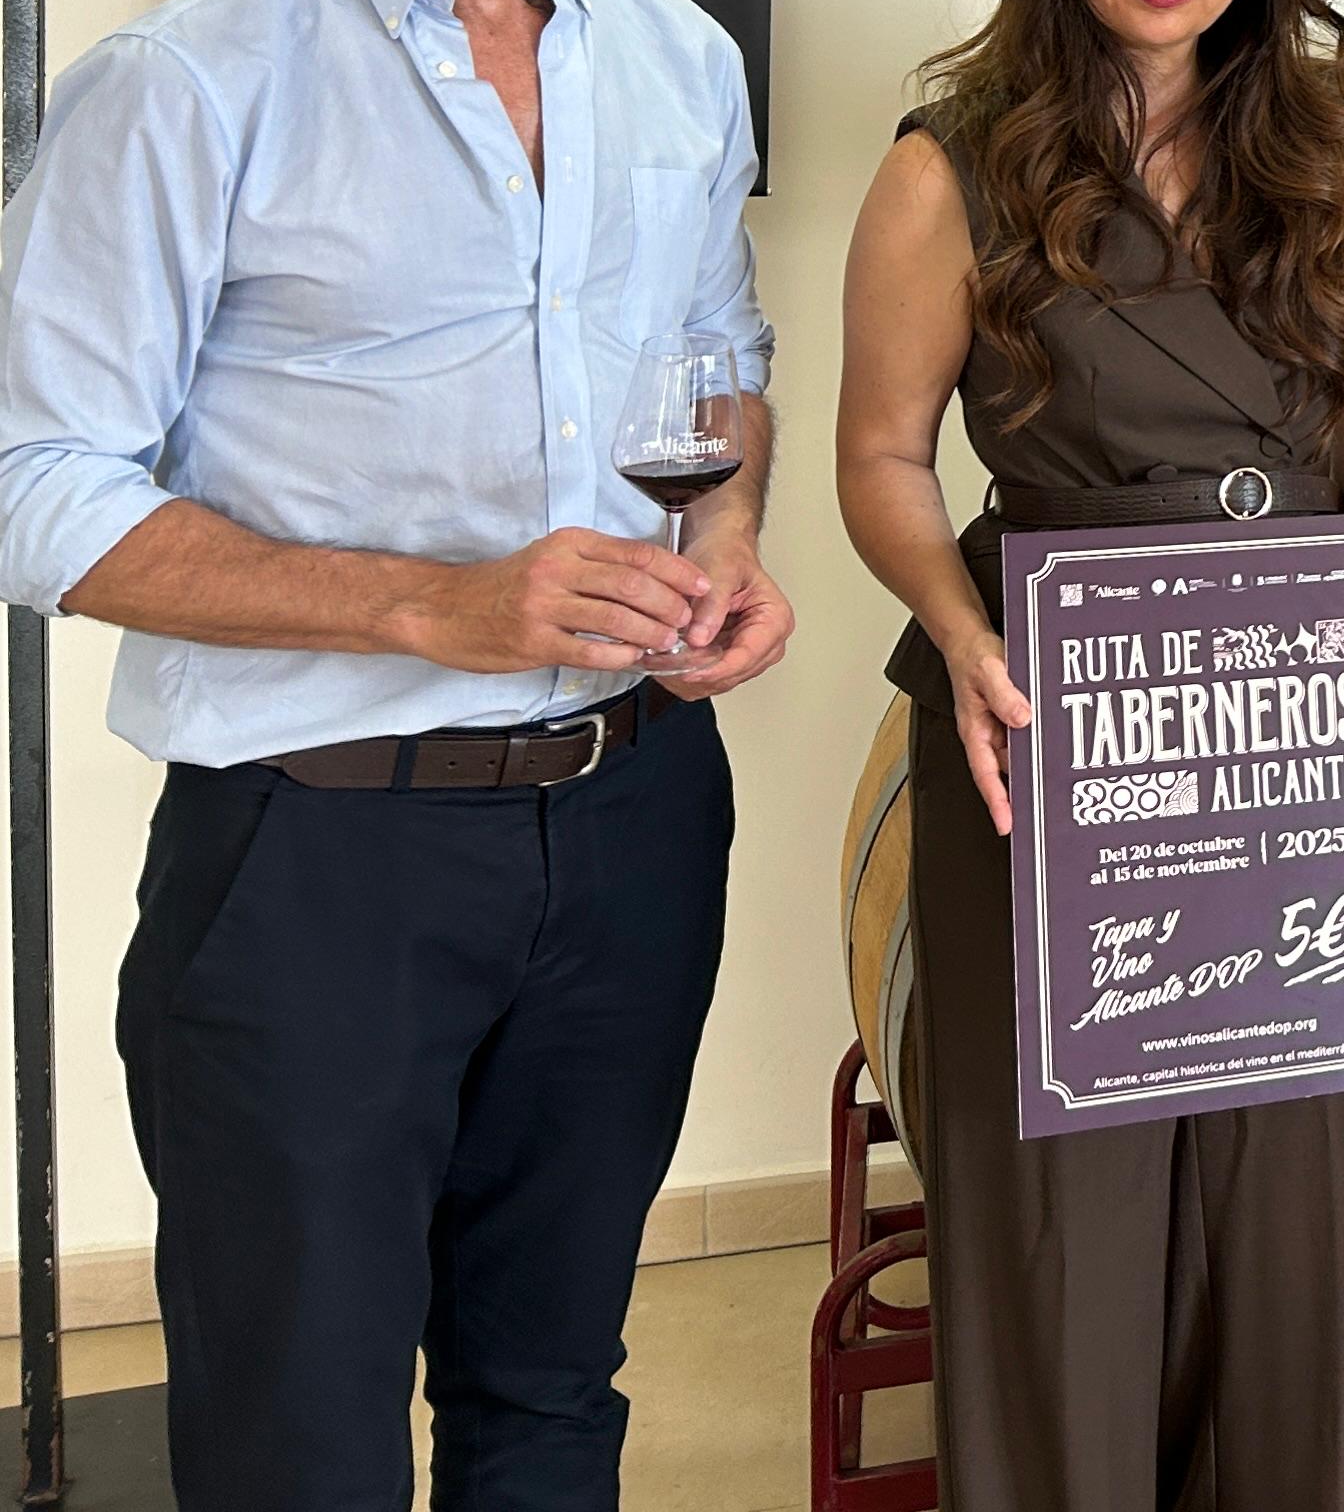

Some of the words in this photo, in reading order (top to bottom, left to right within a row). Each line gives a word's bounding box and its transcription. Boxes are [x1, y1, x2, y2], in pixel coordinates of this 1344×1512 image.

[1061, 634, 1150, 685] RUTA
[1161, 630, 1203, 677] DE
[1090, 869, 1108, 885] al
[1114, 866, 1131, 882] 15
[1133, 862, 1155, 880] de
[1157, 854, 1250, 878] noviembre
[1099, 847, 1128, 864] Del
[1130, 844, 1151, 861] 20
[1154, 841, 1176, 858] de
[1178, 837, 1246, 856] octubre
[1088, 915, 1156, 955] Tapa
[1156, 908, 1181, 944] y
[1091, 951, 1155, 989] Vino
[1070, 973, 1186, 1031] Alicante
[1188, 948, 1263, 997] DOP
[1141, 1018, 1318, 1052] www.vinosalicantedop.org
[1093, 1074, 1141, 1089] Alicante,
[1142, 1067, 1179, 1083] capital
[1180, 1062, 1226, 1077] histórica
[1227, 1058, 1244, 1070] del
[1245, 1056, 1269, 1068] vino
[1270, 1054, 1284, 1065] en
[1285, 1050, 1296, 1061] el
